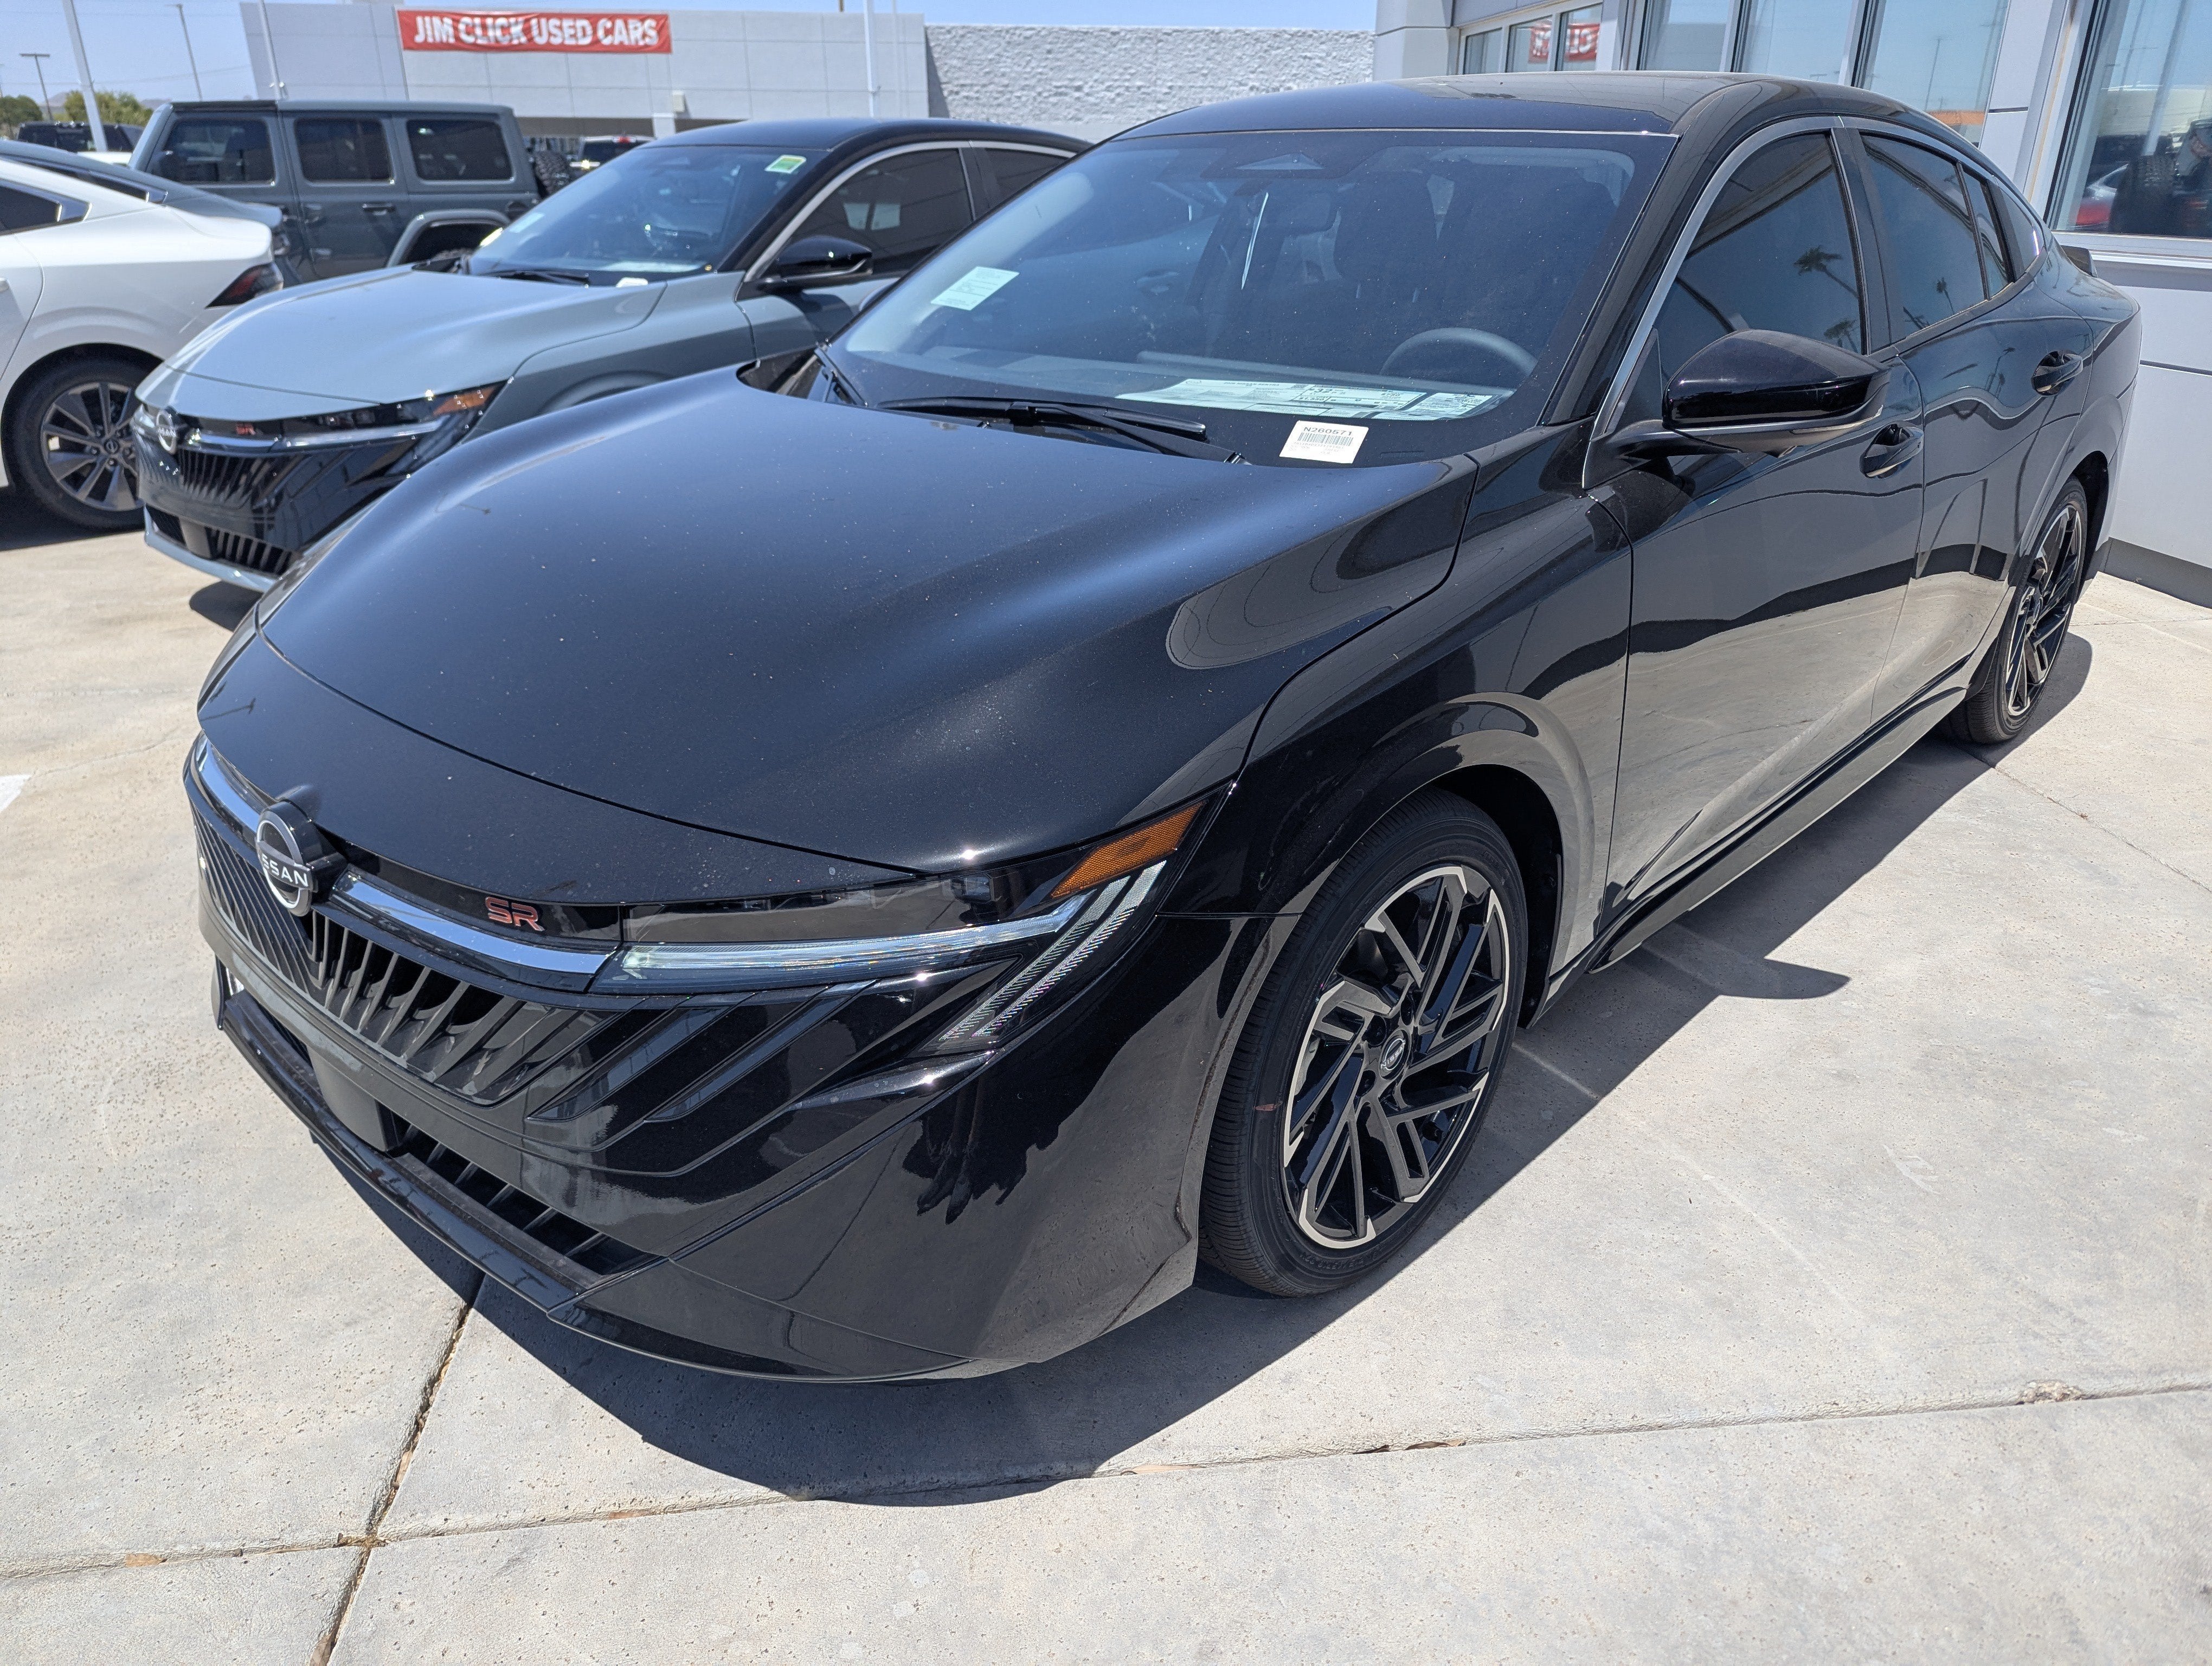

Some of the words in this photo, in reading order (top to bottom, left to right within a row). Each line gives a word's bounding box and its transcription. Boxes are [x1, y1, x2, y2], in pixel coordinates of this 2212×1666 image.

[414, 16, 455, 43] JIM
[458, 16, 528, 44] CLICK
[530, 17, 593, 45] USED
[597, 18, 659, 45] CARS
[1304, 427, 1352, 436] N260571
[261, 853, 308, 887] SSAN
[485, 896, 545, 932] SR
[1380, 1040, 1406, 1069] NISSAN
